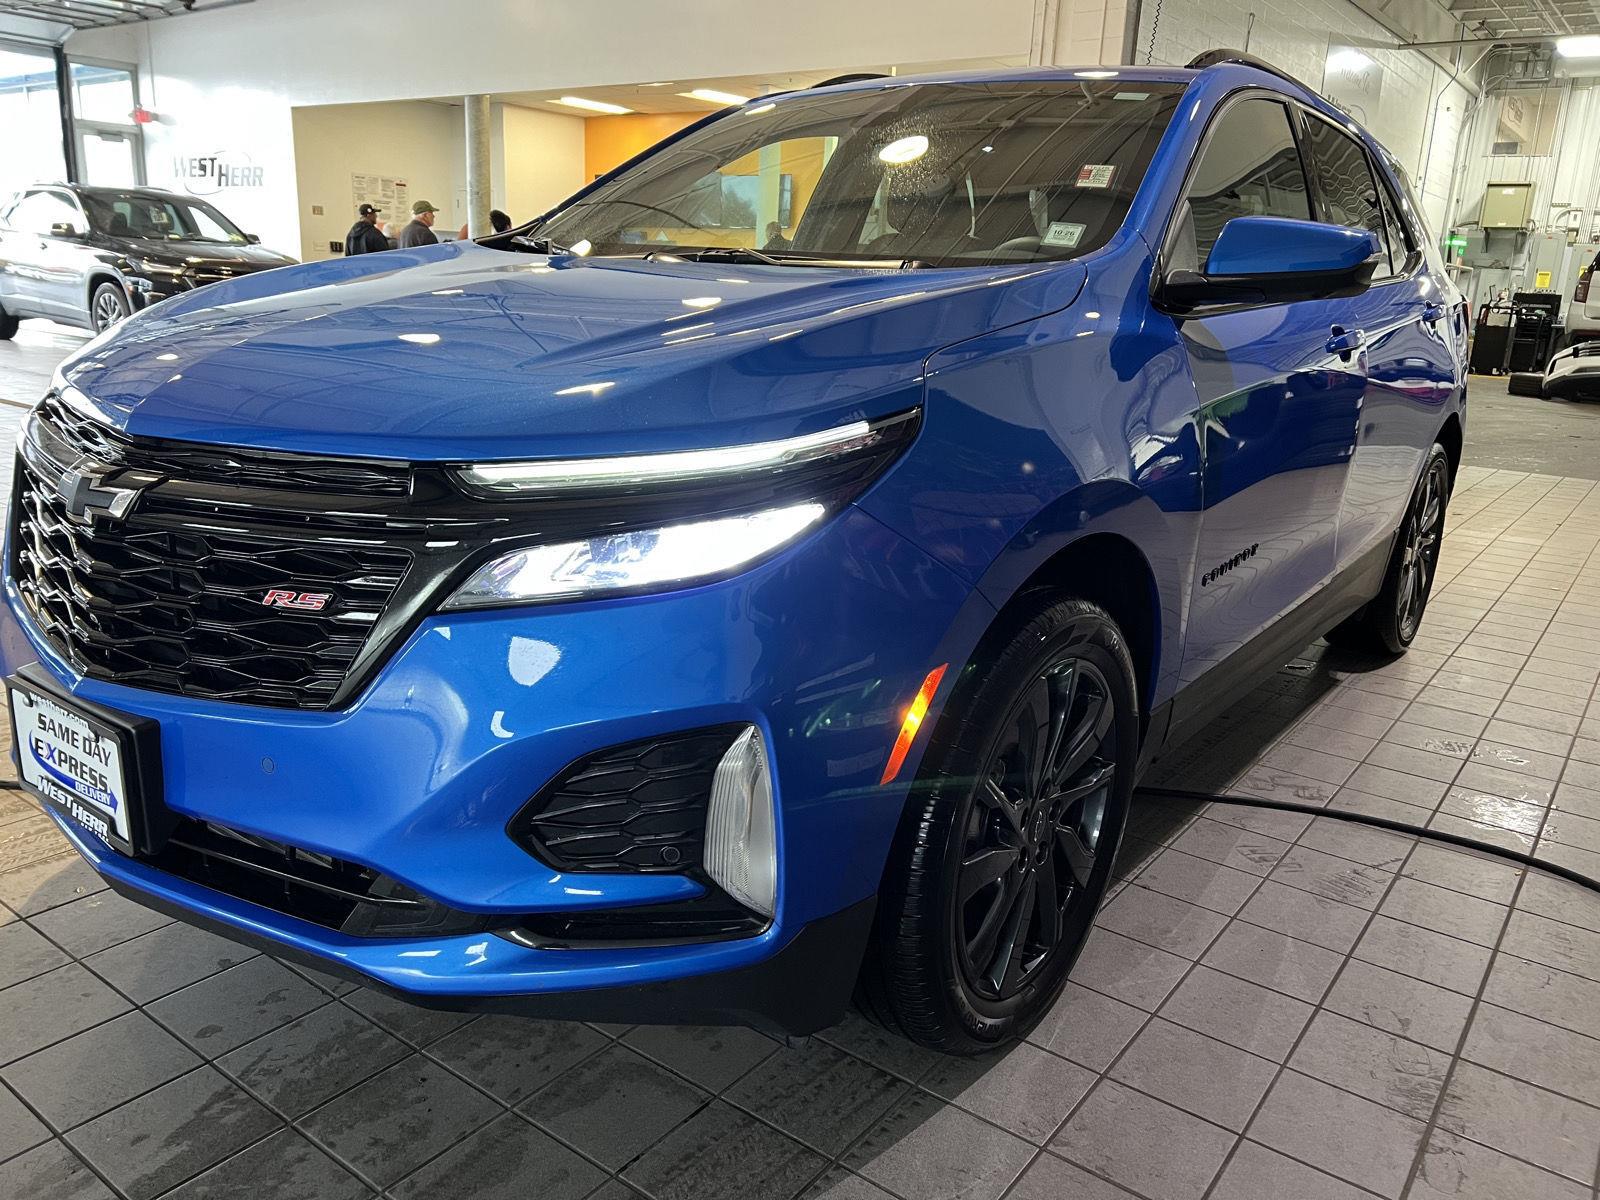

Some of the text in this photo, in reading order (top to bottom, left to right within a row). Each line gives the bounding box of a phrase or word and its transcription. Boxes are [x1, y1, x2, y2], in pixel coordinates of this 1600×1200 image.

[174, 154, 264, 187] WEST HERR
[262, 589, 332, 610] RS
[37, 712, 112, 768] SAME DAY
[34, 737, 109, 793] EXPRESS
[37, 775, 74, 809] WEST
[71, 801, 109, 838] HERR
[74, 780, 112, 806] DELIVERY
